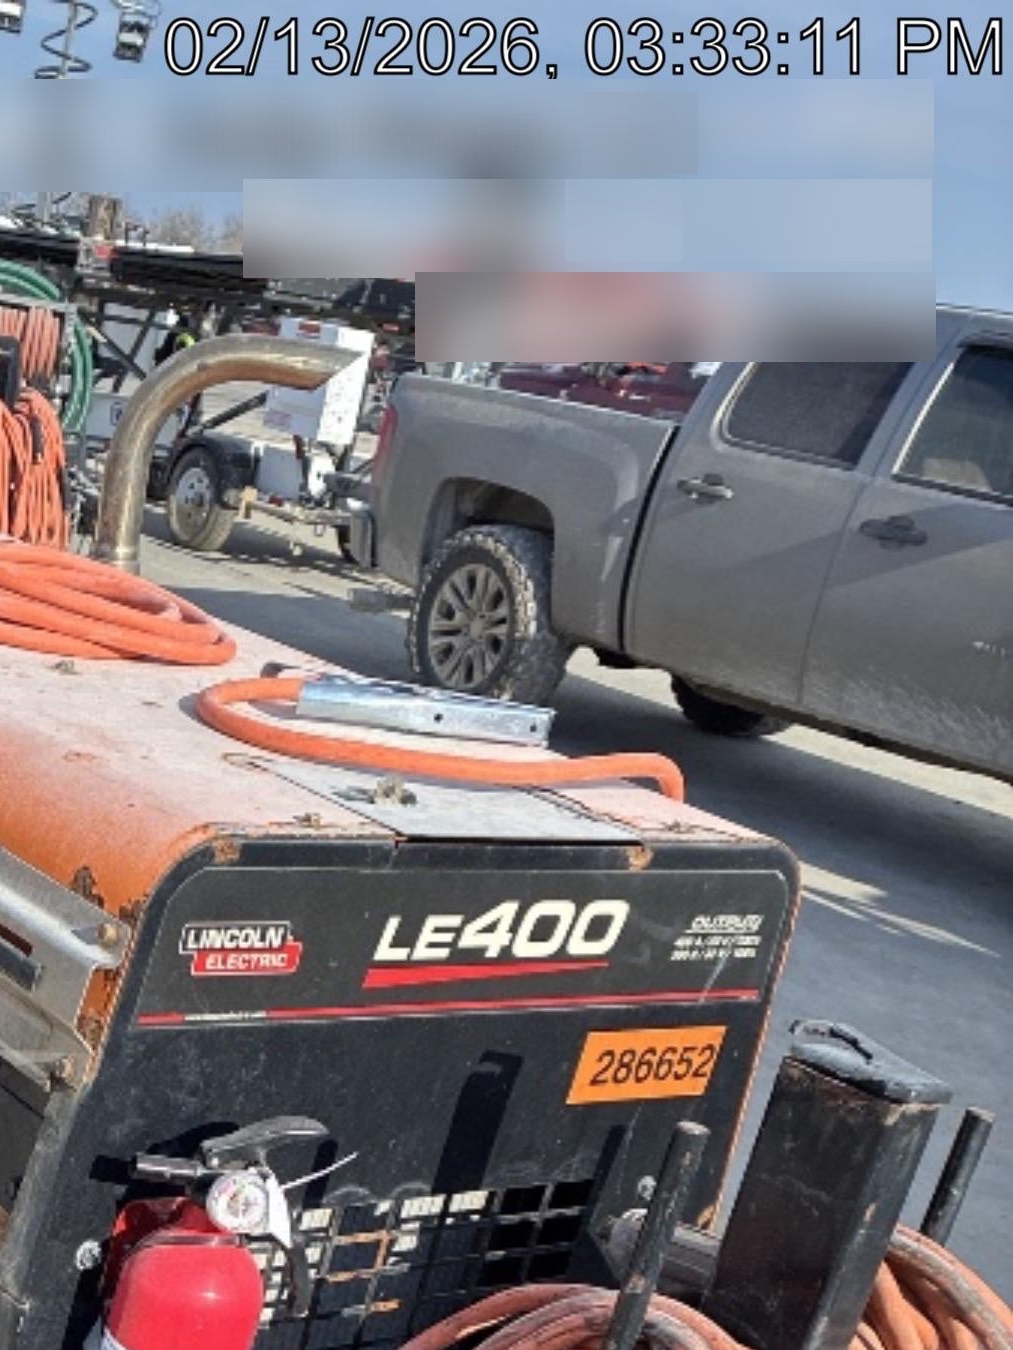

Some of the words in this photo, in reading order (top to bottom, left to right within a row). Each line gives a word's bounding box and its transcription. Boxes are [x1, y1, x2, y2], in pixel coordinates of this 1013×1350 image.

[186, 925, 286, 949] LINCOLN
[372, 899, 631, 961] LE400
[204, 952, 289, 971] ELECTRIC
[589, 1042, 717, 1087] 286652
